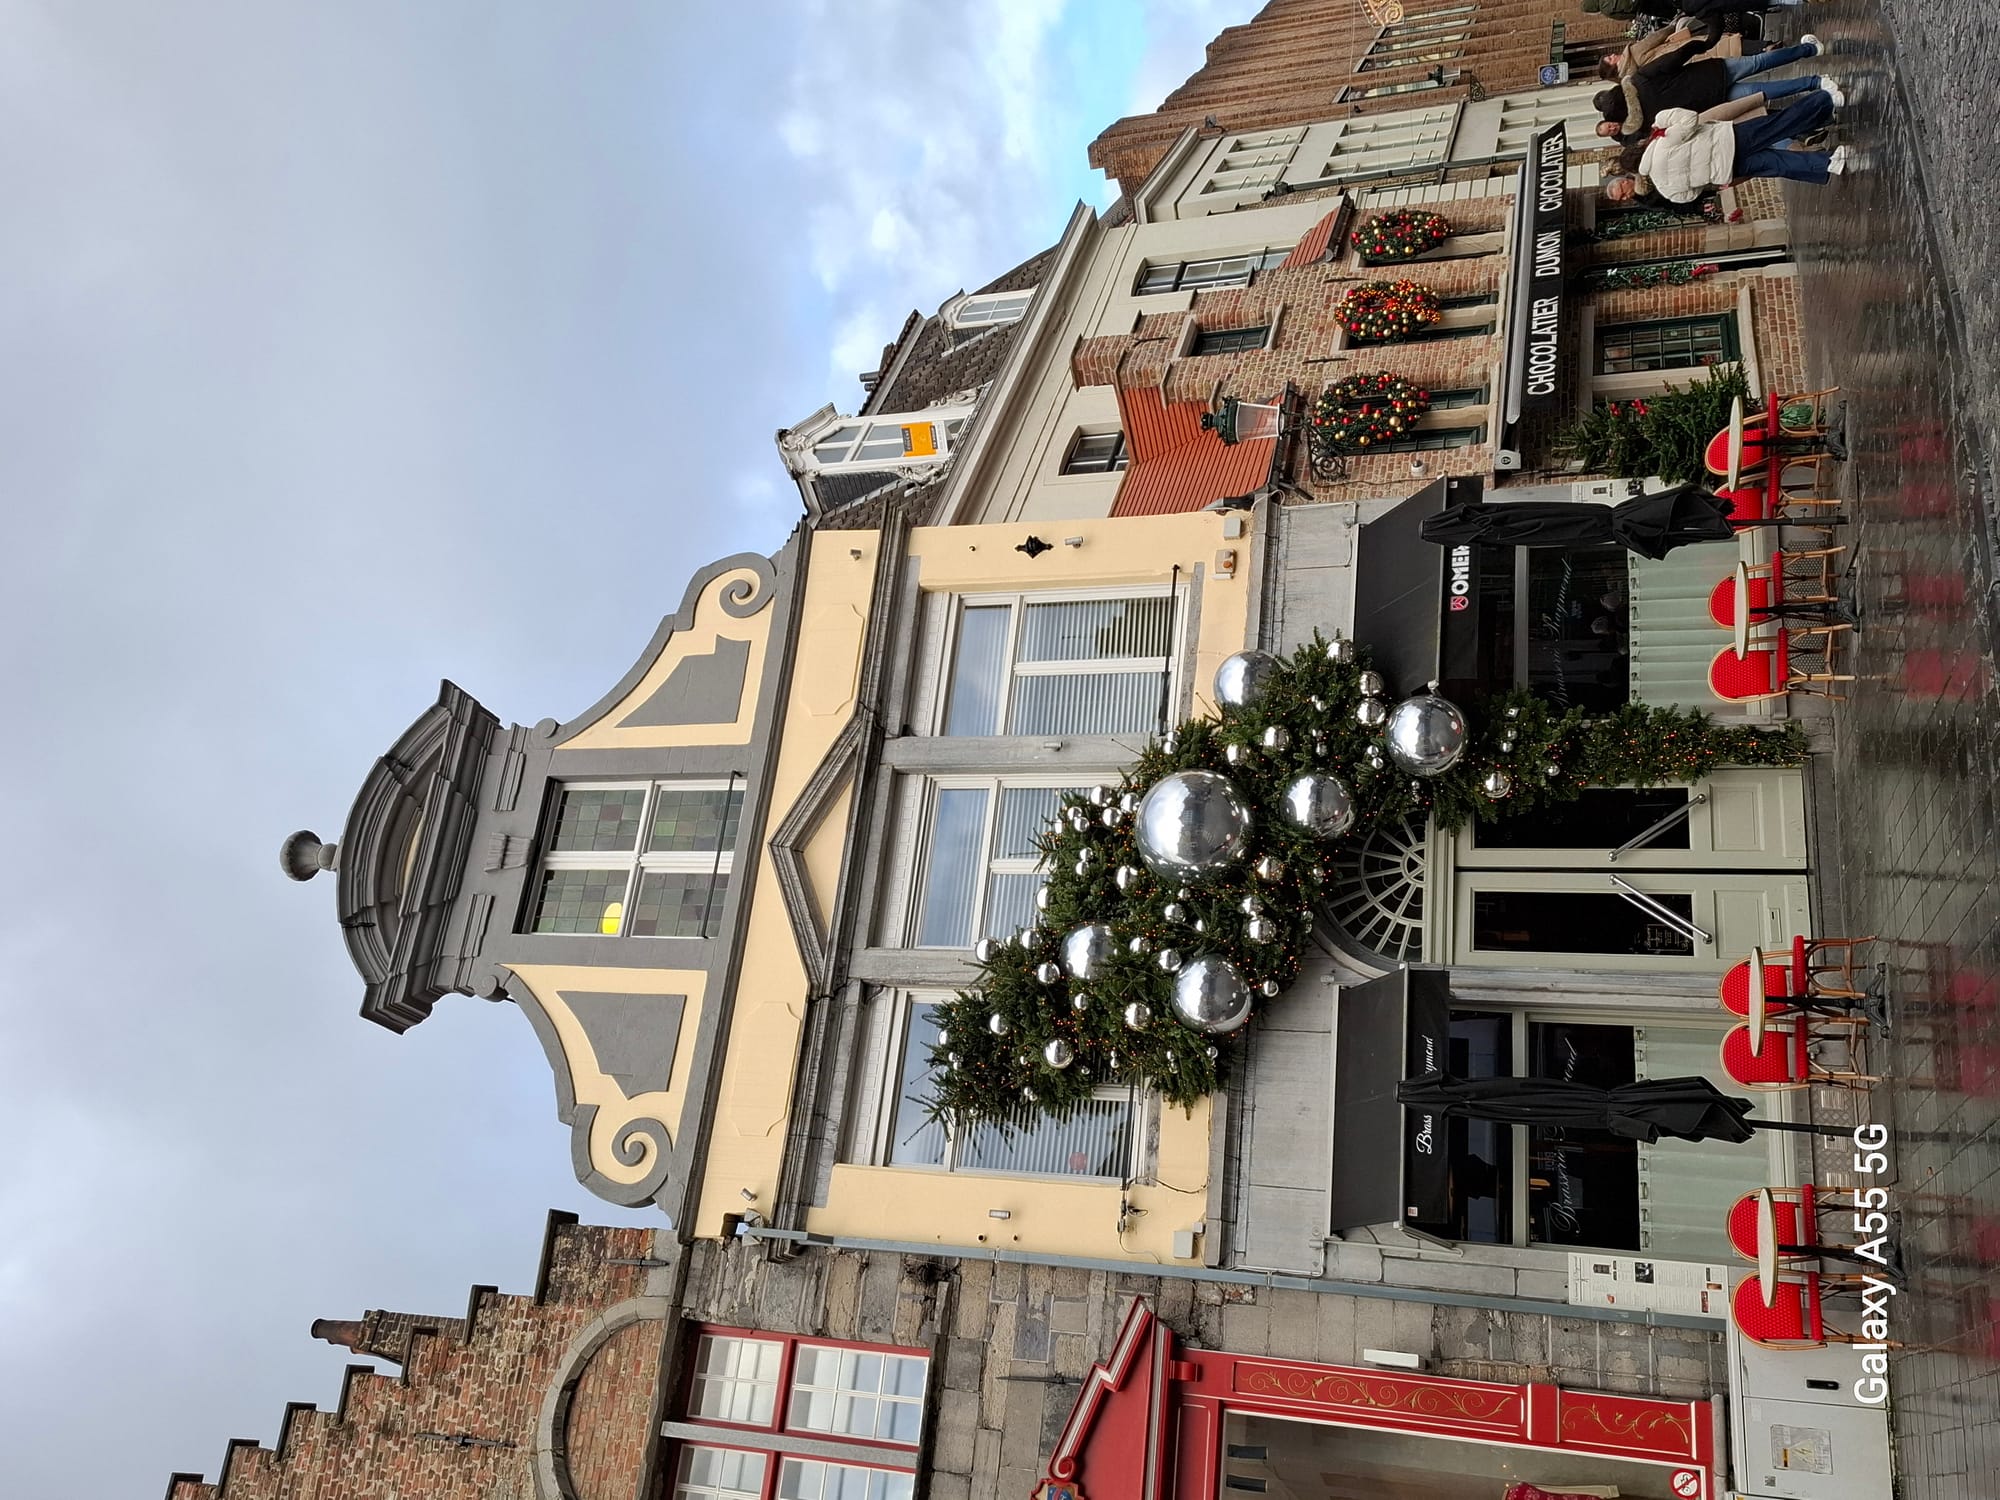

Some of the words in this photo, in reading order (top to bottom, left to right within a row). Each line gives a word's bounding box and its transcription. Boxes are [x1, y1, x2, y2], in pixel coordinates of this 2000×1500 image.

[1539, 132, 1565, 212] CHOCOLATIER
[1535, 231, 1562, 277] DUMON
[1527, 296, 1560, 395] CHOCOLATIER
[1421, 1034, 1438, 1075] ymond
[1415, 1113, 1433, 1154] Brass
